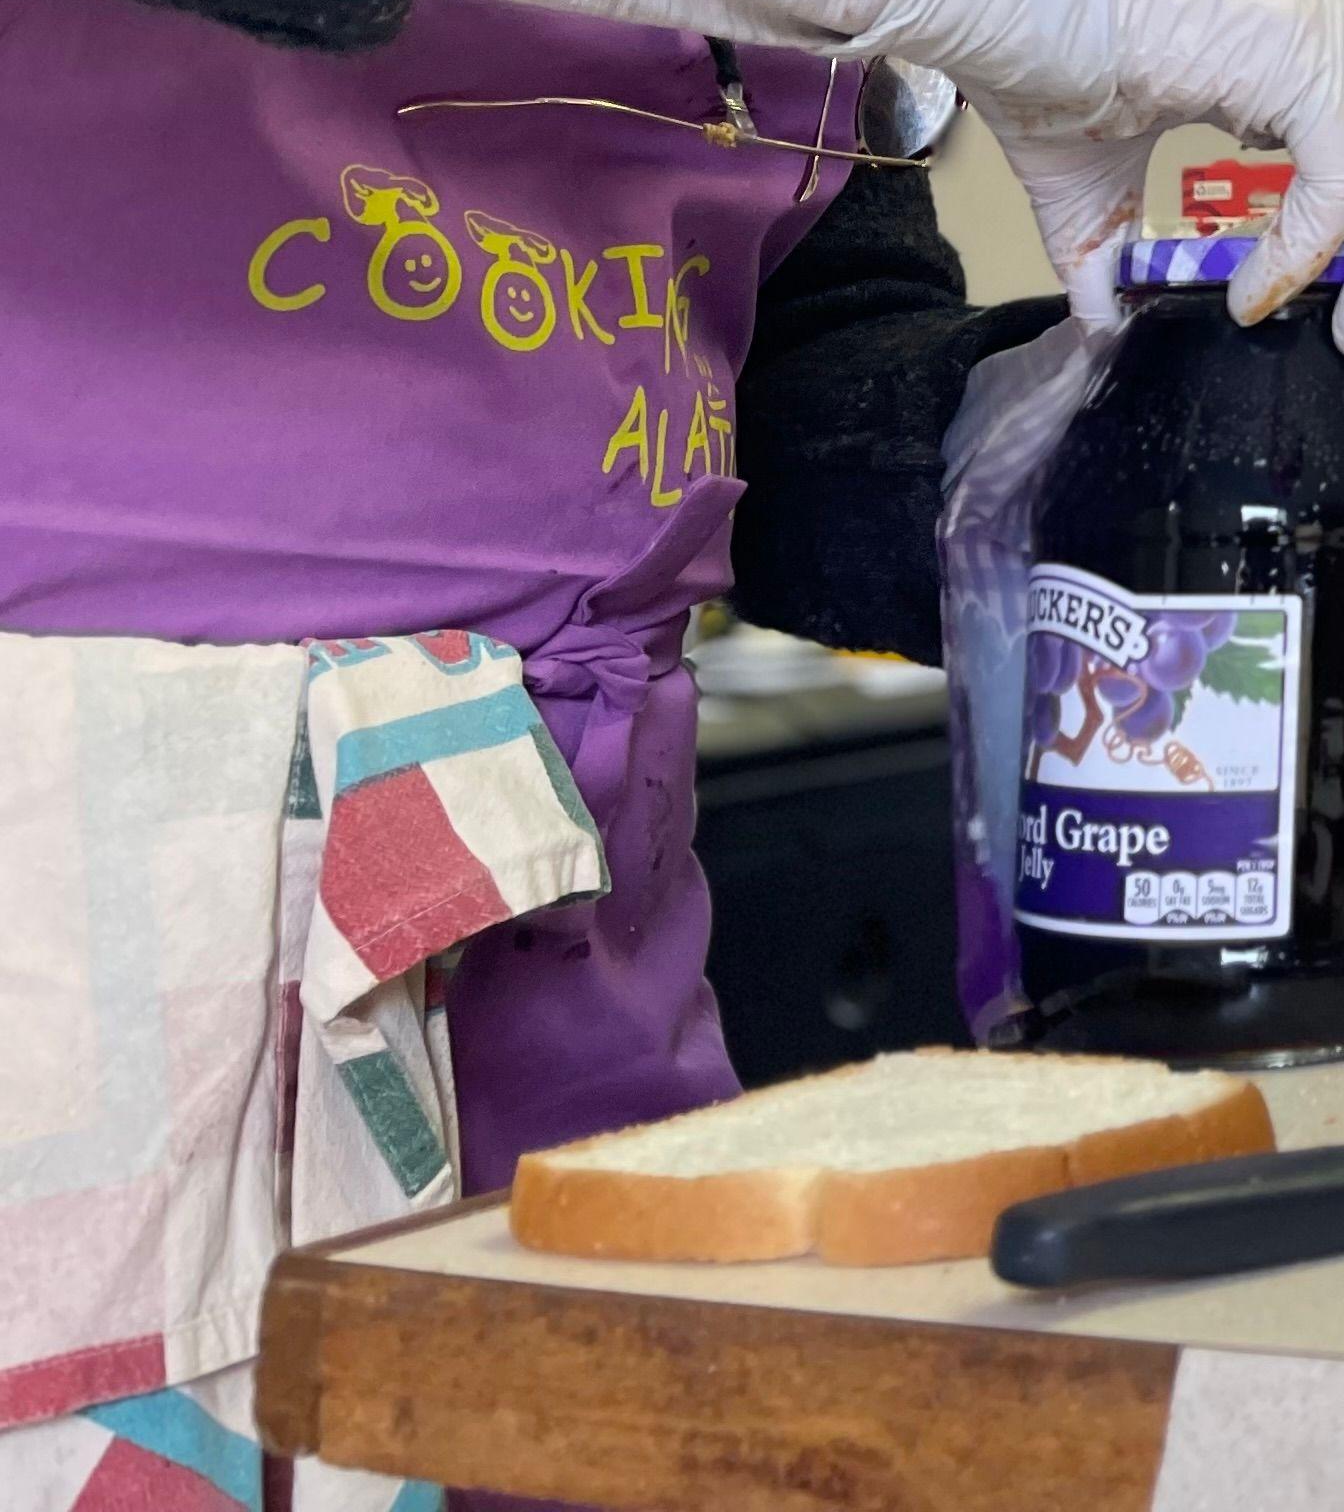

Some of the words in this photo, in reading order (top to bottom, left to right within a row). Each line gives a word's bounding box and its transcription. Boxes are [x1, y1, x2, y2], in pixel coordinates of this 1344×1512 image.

[1055, 808, 1171, 867] Grape
[1018, 843, 1055, 891] Jelly
[1134, 877, 1151, 898] 50
